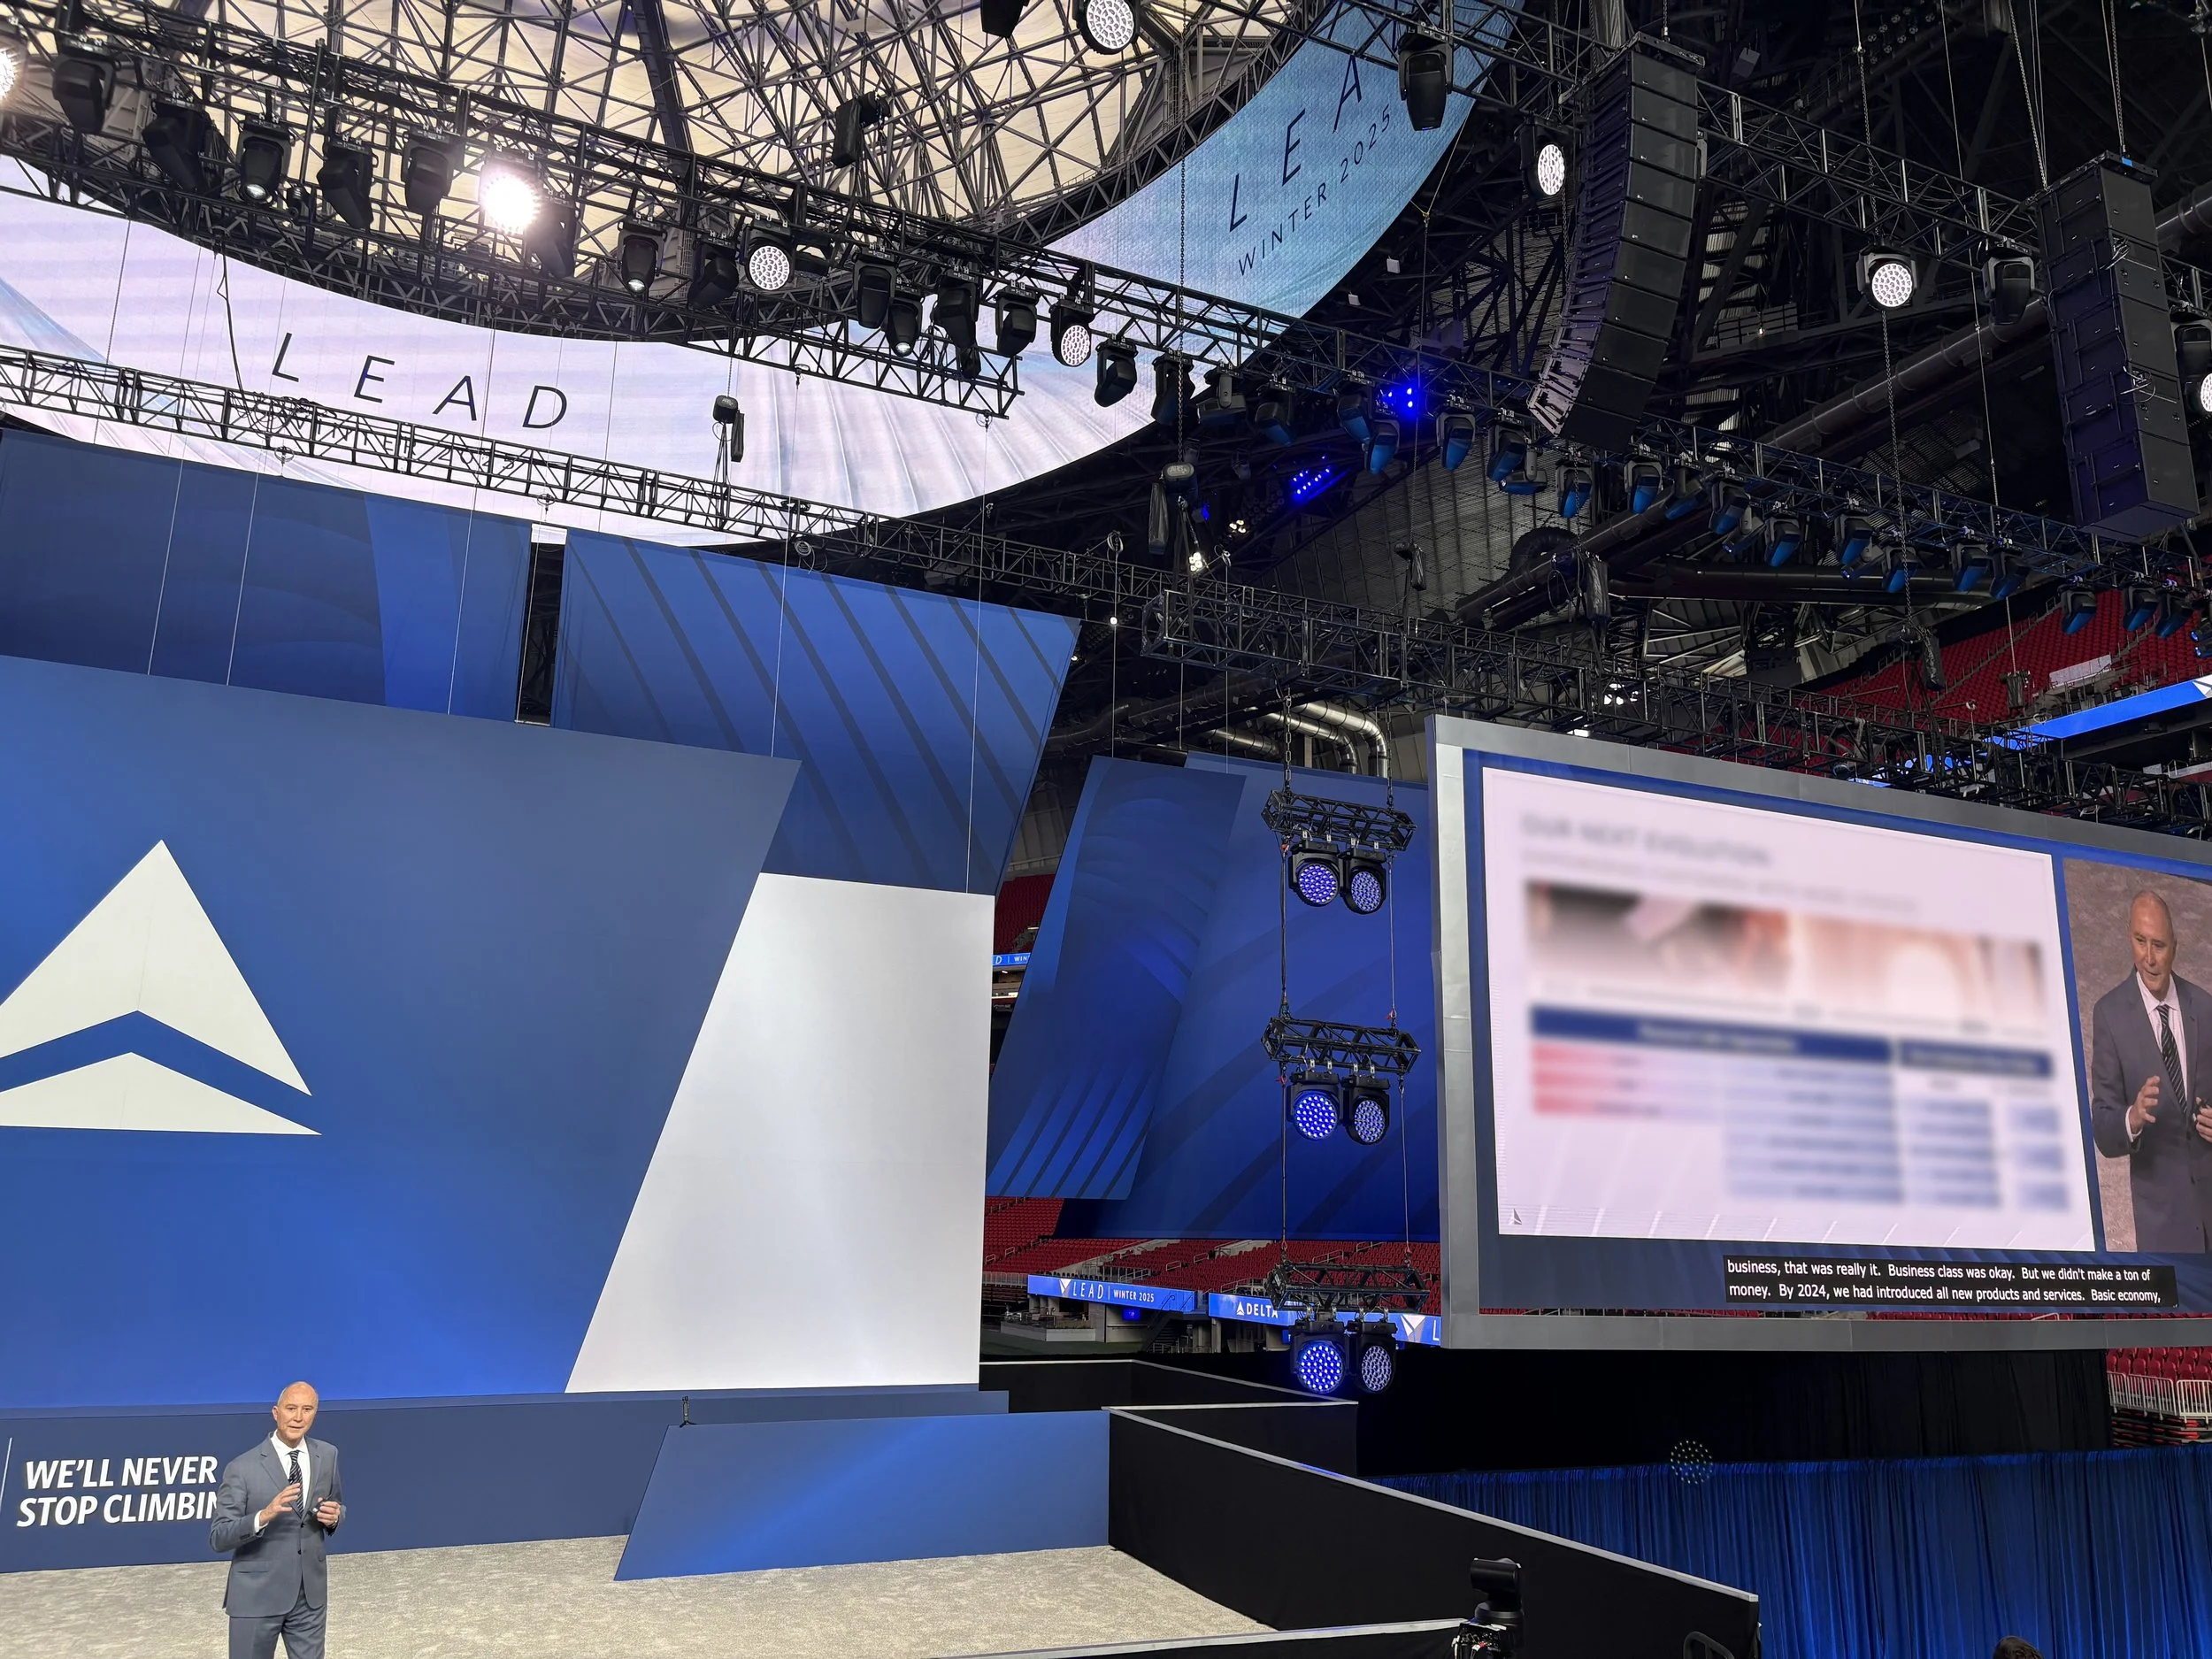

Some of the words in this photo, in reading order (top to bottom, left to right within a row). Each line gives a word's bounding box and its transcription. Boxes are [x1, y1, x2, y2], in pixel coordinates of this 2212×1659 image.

[1239, 183, 1326, 276] WINTER
[1340, 104, 1391, 183] 2025
[272, 333, 568, 429] LEAD
[1727, 1259, 1781, 1277] business,
[1784, 1261, 1809, 1275] that
[1810, 1263, 1833, 1275] was
[1836, 1263, 1866, 1279] really
[1869, 1263, 1881, 1277] it.
[1888, 1263, 1935, 1278] Business
[1938, 1264, 1963, 1279] class
[1966, 1268, 1986, 1279] was
[1988, 1265, 2016, 1282] okay.
[2021, 1266, 2039, 1279] But
[2041, 1270, 2055, 1280] we
[2058, 1267, 2085, 1280] didn't
[2087, 1268, 2114, 1281] make
[2116, 1271, 2122, 1281] a
[2124, 1269, 2139, 1281] ton
[2141, 1269, 2151, 1281] of
[1072, 1282, 1104, 1300] LEAD
[1113, 1289, 1137, 1301] WINTER
[1139, 1292, 1155, 1302] 2025
[1729, 1284, 1771, 1300] money.
[1778, 1284, 1793, 1300] By
[1797, 1284, 1830, 1301] 2024,
[1833, 1287, 1850, 1298] we
[1853, 1285, 1873, 1299] had
[1876, 1286, 1933, 1300] introduced
[1936, 1286, 1949, 1300] all
[1952, 1289, 1973, 1300] new
[1976, 1287, 2020, 1302] products
[2022, 1287, 2040, 1301] and
[2043, 1288, 2085, 1302] services.
[2091, 1289, 2116, 1302] Basic
[2117, 1291, 2161, 1304] economy,
[1246, 1302, 1278, 1319] DELTA
[121, 1455, 219, 1486] NEVER
[16, 1495, 98, 1527] STOP
